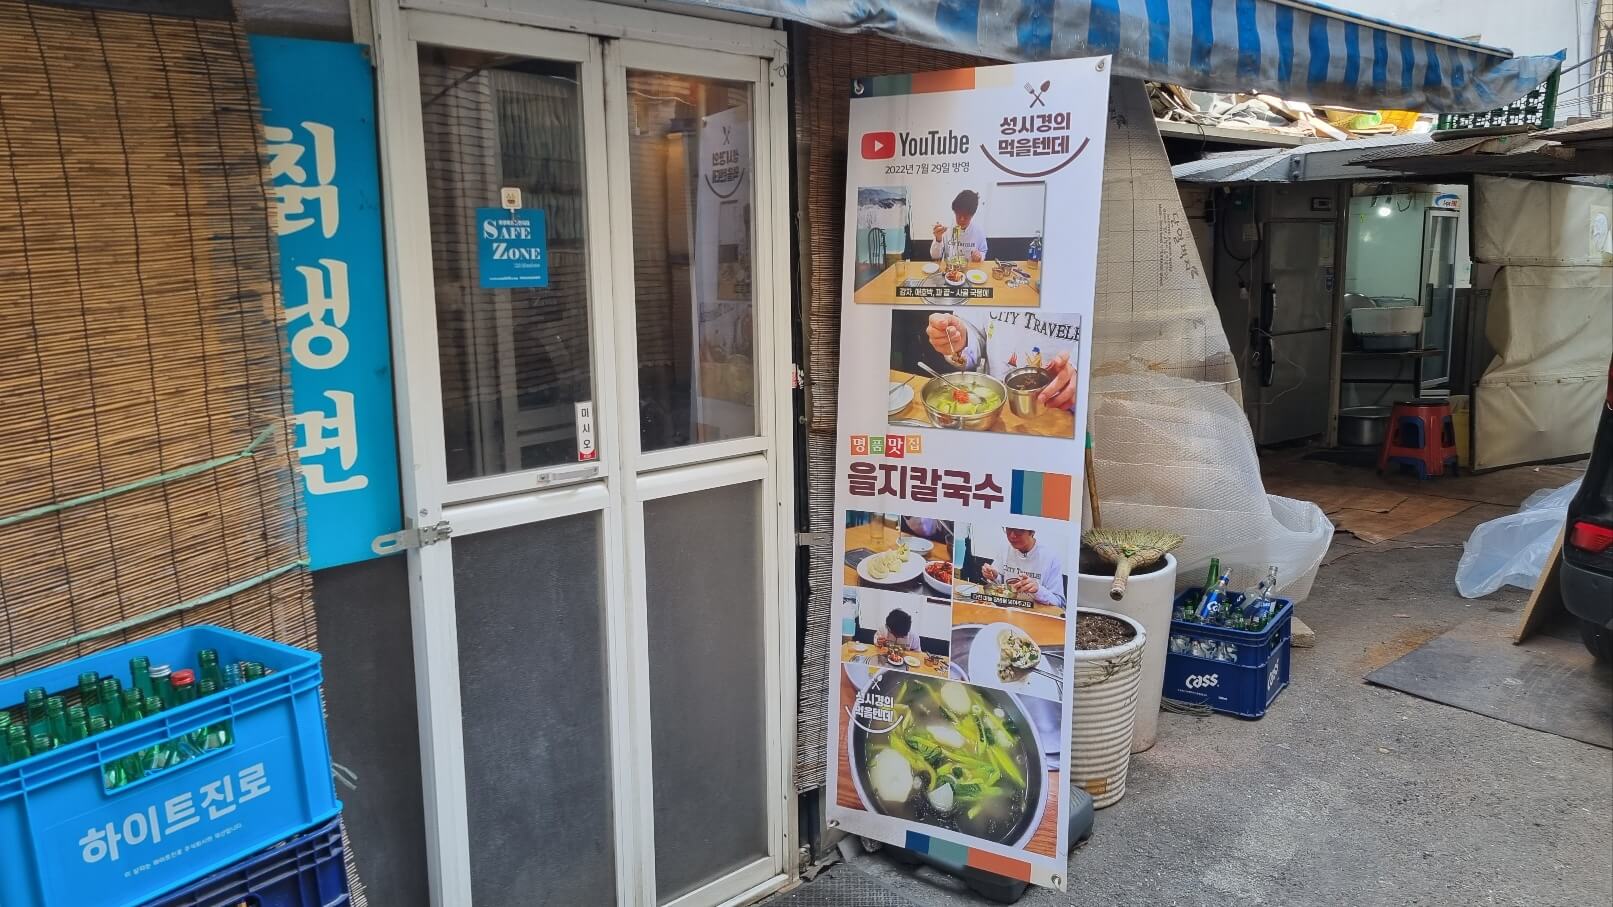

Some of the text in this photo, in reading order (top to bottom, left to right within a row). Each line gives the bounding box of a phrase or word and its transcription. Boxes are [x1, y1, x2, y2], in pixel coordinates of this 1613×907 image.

[999, 112, 1071, 135] 성시경의
[899, 130, 970, 157] YouTube
[998, 135, 1070, 157] 먹을텐데
[885, 162, 970, 175] 2022년 7월 29일 방영
[483, 219, 531, 239] SAFE
[492, 242, 541, 260] ZONE
[581, 408, 591, 449] 미시오
[852, 437, 921, 456] 명품맛집
[848, 462, 1004, 509] 을지칼국수
[856, 692, 894, 709] 성시경의
[78, 762, 271, 863] 하이트진로
